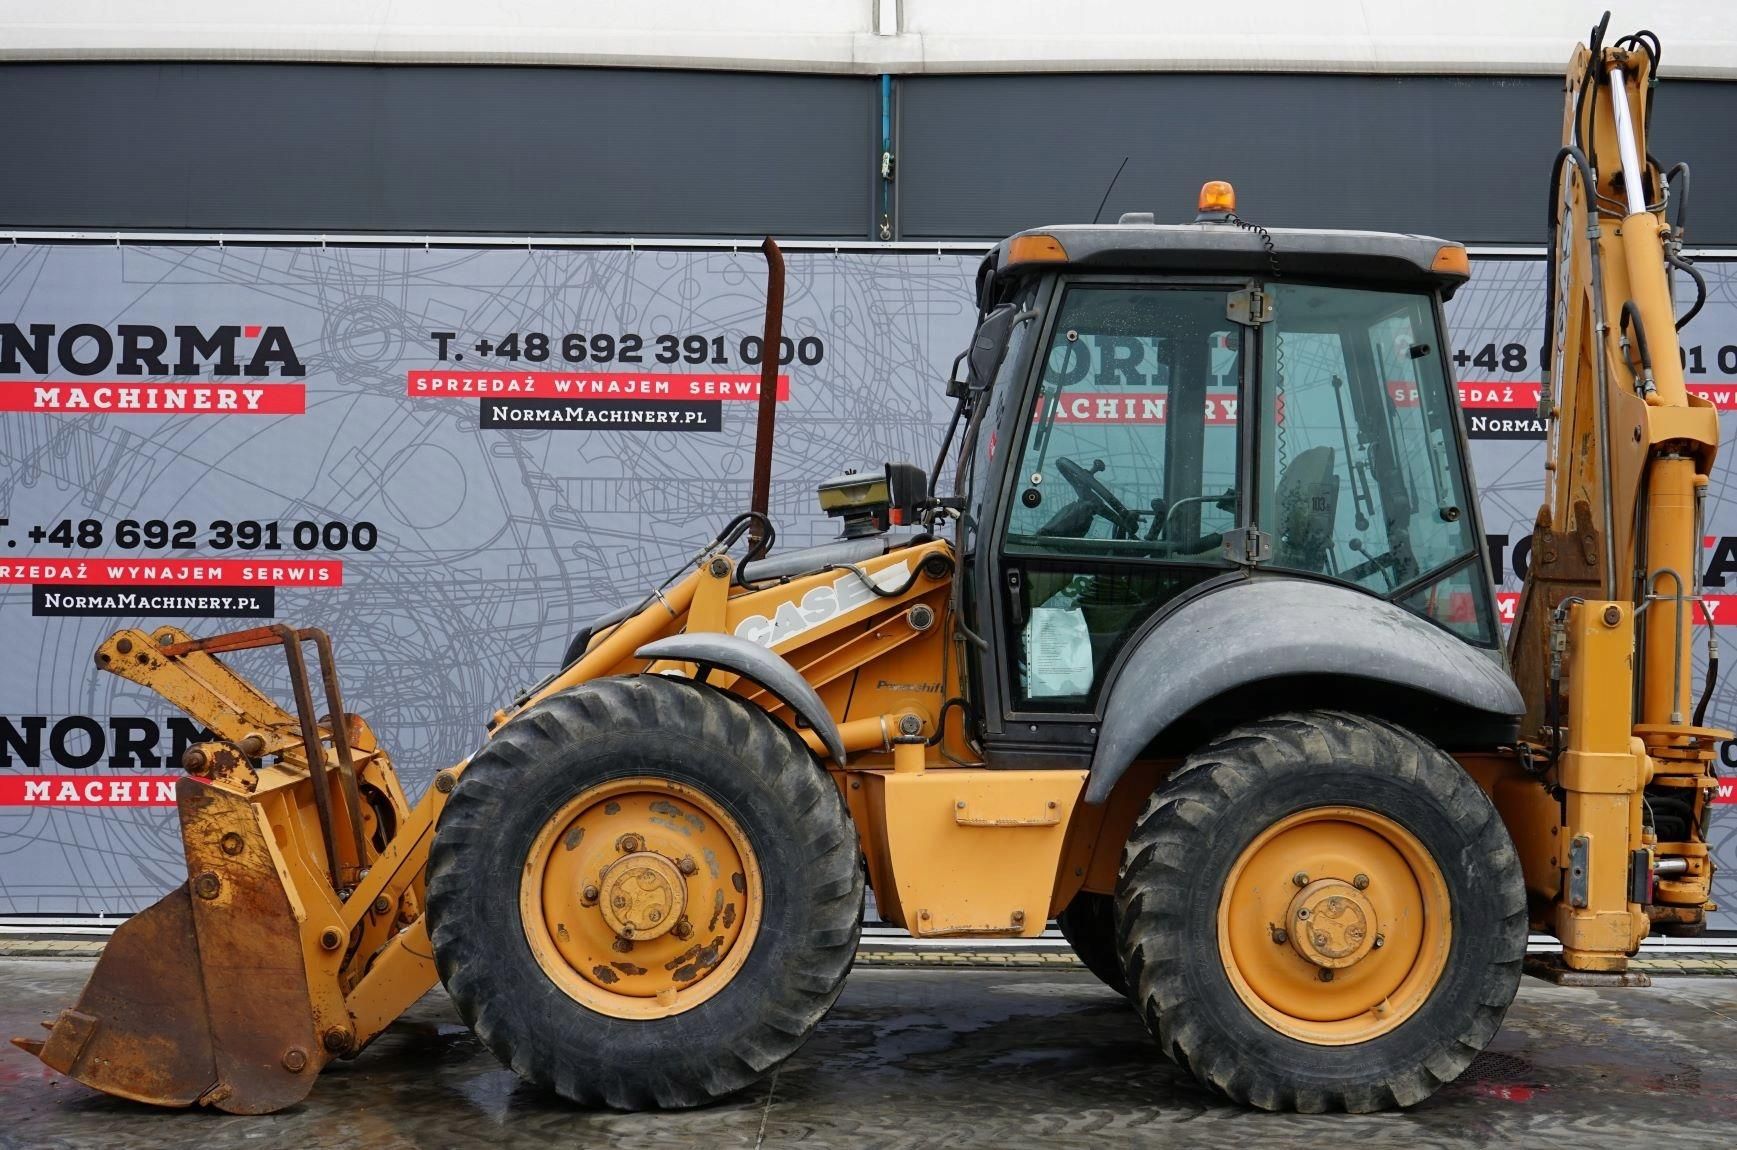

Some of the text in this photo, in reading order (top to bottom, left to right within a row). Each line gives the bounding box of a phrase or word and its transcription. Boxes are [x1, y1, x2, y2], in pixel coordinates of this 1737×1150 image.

[0, 323, 306, 377] NORMA
[431, 332, 463, 361] T.
[475, 332, 549, 362] +48
[561, 333, 643, 363] 692
[655, 335, 728, 364] 391
[1453, 343, 1527, 372] +48
[34, 387, 264, 409] MACHINERY
[417, 376, 763, 395] SPRZEDAŻ WYNAJEM SERWI
[28, 519, 103, 549] +48
[115, 520, 197, 549] 692
[208, 521, 282, 550] 391
[292, 521, 378, 552] 000
[107, 567, 223, 580] WYNAJEM
[242, 567, 330, 581] SERWIS
[734, 566, 885, 648] CASE
[24, 781, 177, 802] MACHIN
